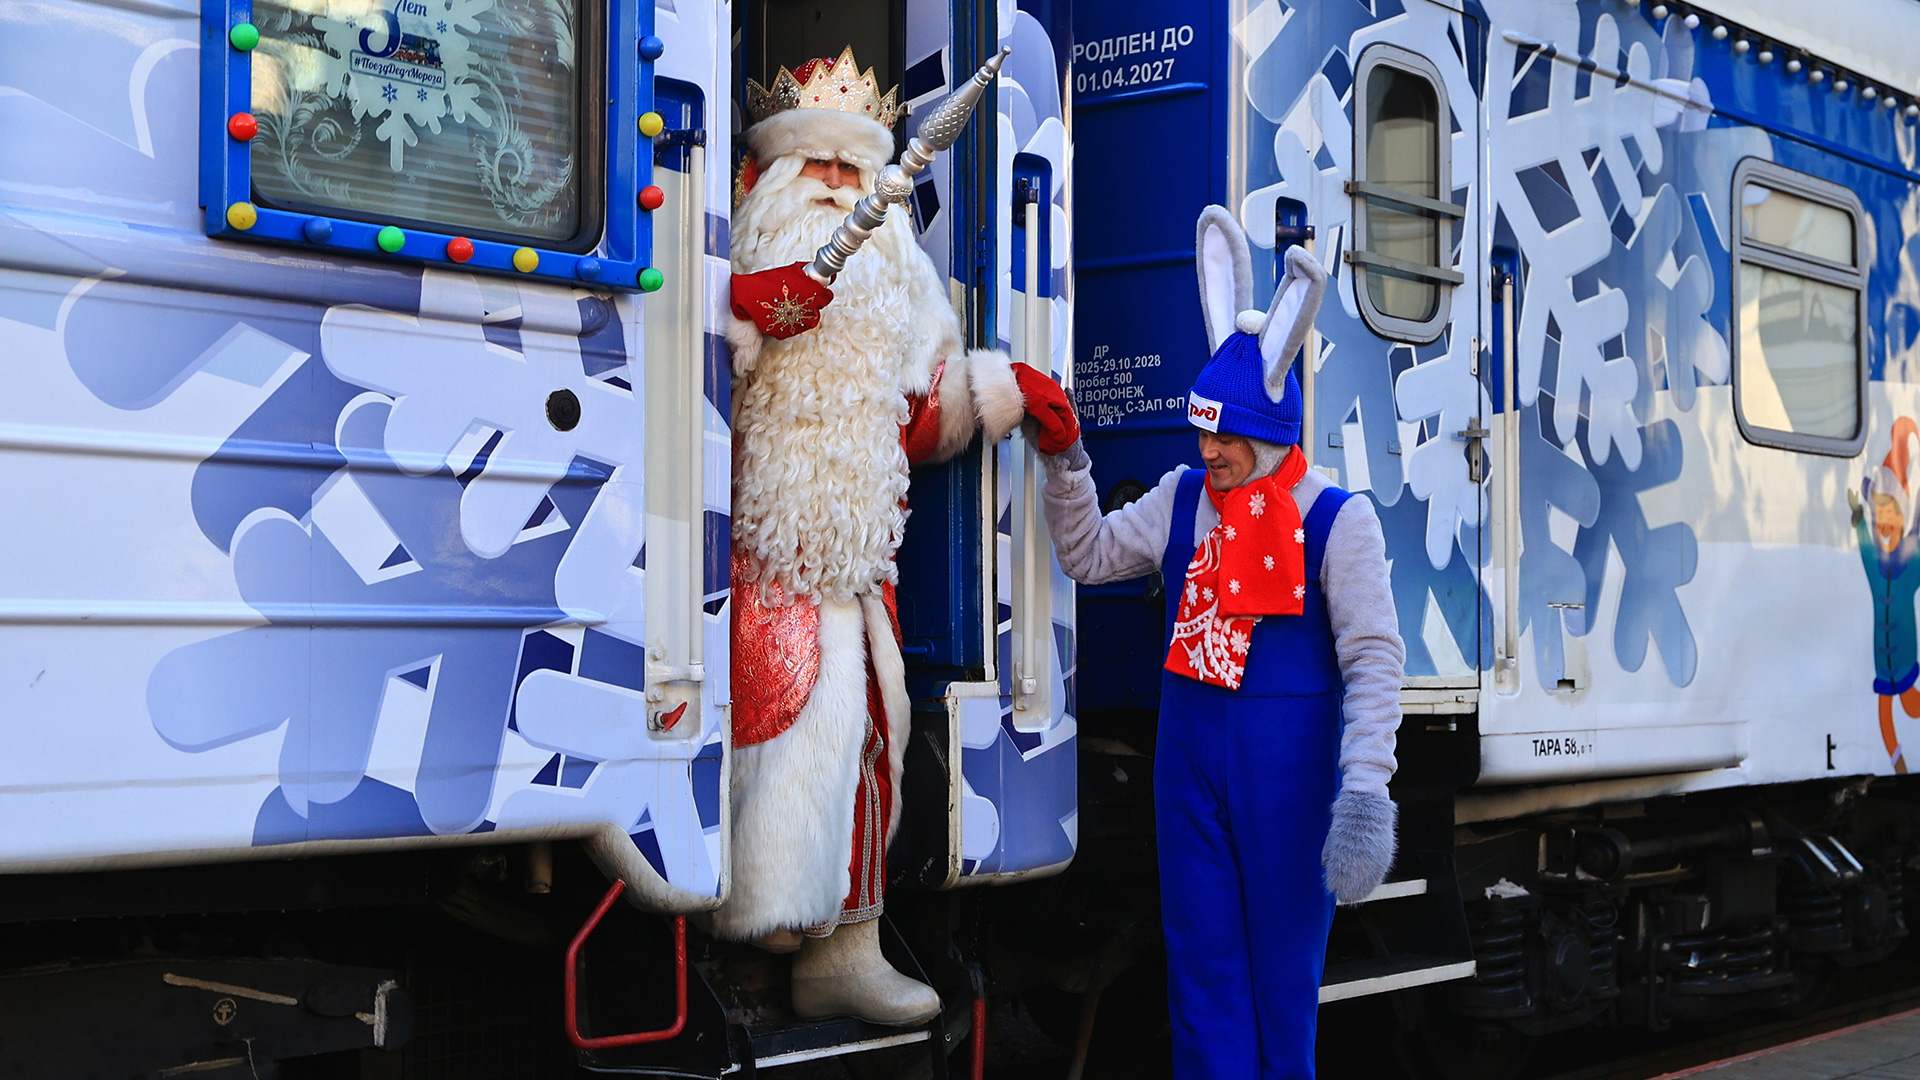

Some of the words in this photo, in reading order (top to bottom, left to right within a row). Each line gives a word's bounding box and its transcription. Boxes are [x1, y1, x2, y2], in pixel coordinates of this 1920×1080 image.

[1161, 25, 1194, 53] ДО
[1076, 58, 1175, 93] 01.04.2027
[1093, 345, 1110, 360] ДР
[1113, 371, 1133, 385] 500
[1085, 385, 1145, 403] ВОРОНЕЖ
[1126, 398, 1163, 413] С-ЗАП
[1532, 738, 1562, 757] ТАРА
